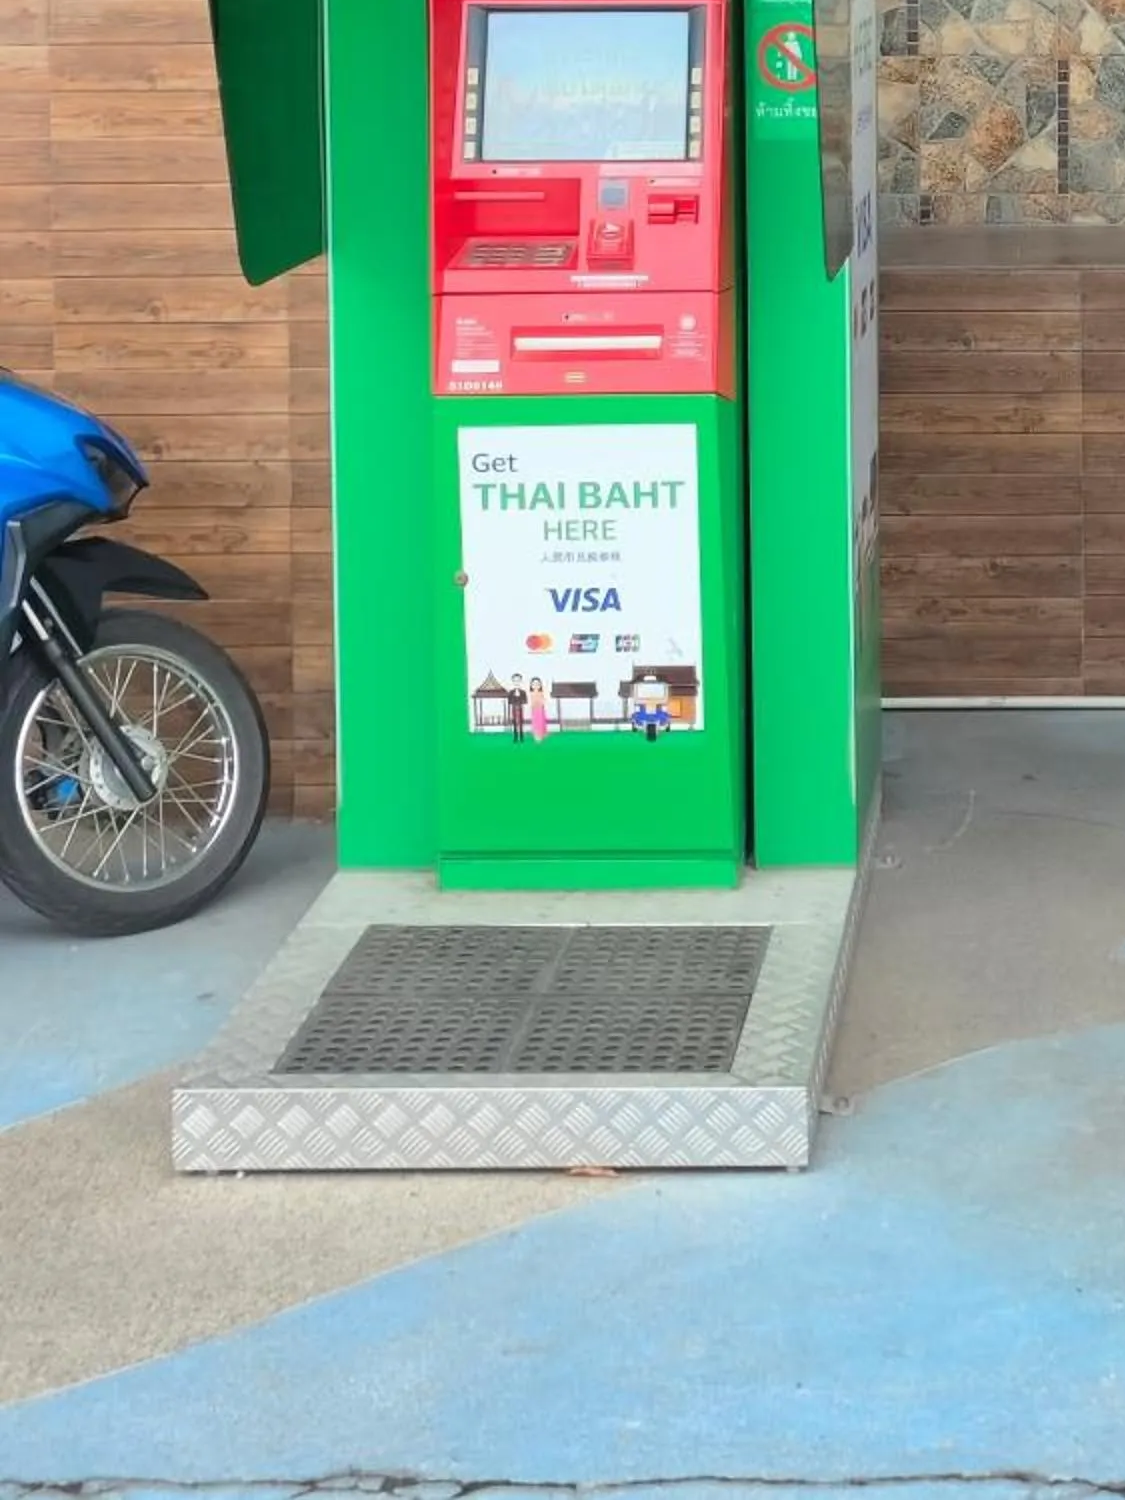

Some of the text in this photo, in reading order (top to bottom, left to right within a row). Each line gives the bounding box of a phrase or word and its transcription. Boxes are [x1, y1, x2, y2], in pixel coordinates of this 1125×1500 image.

[472, 453, 518, 473] Get
[472, 480, 686, 511] THAI BAHT
[543, 518, 618, 542] HERE
[546, 587, 623, 613] VISA
